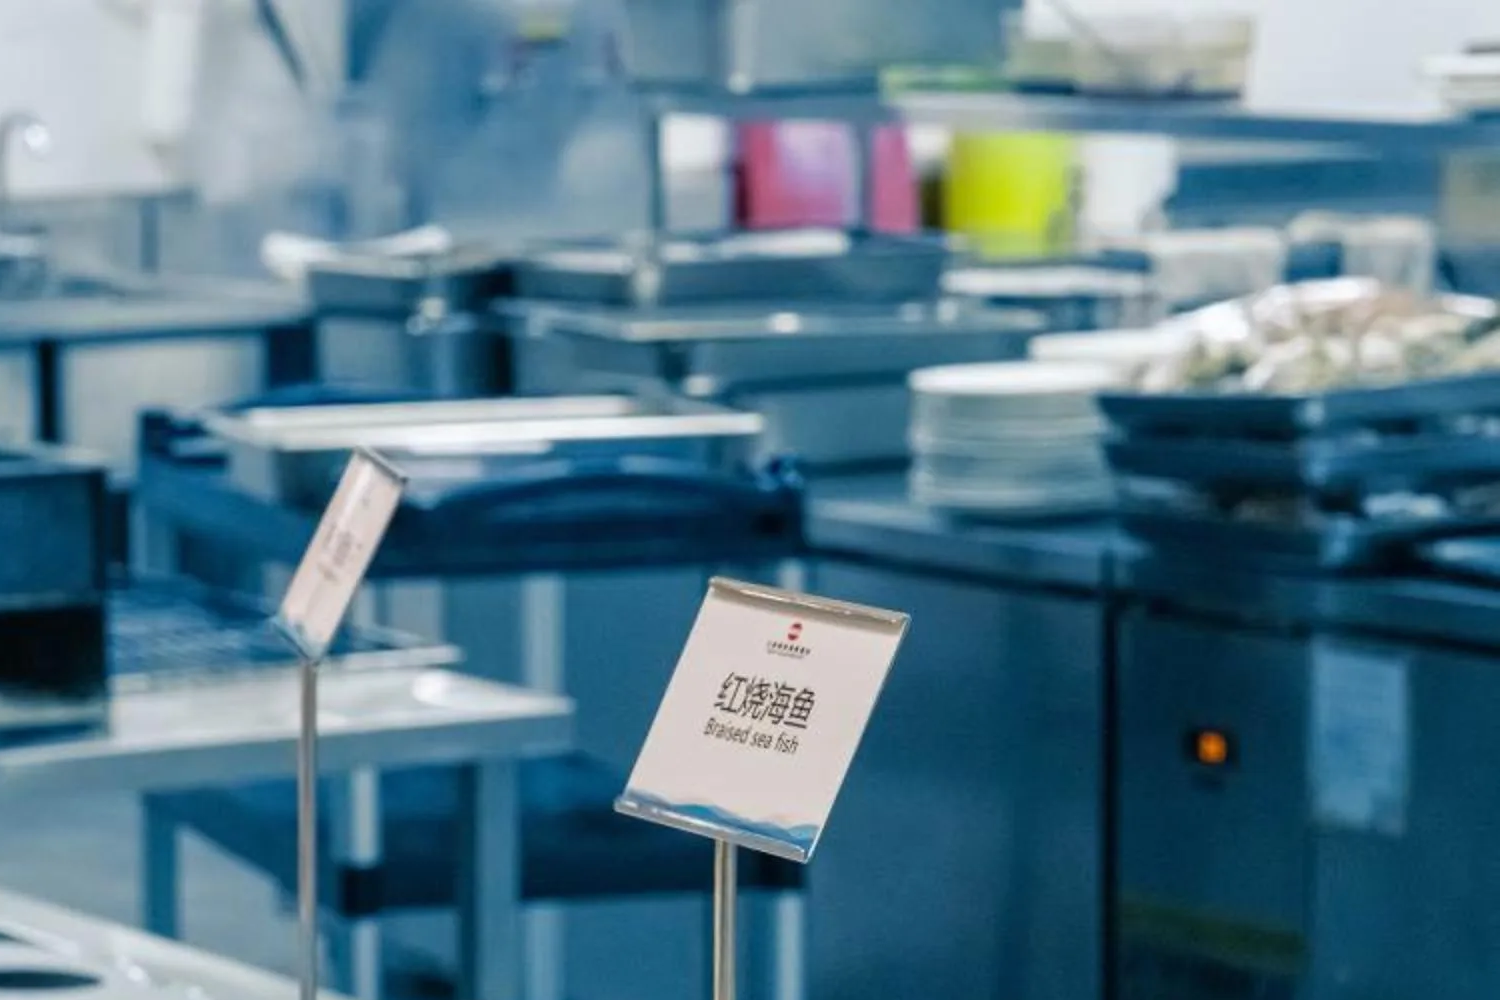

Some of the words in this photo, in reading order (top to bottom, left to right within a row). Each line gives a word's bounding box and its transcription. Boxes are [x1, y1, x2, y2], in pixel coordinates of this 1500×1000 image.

[714, 672, 815, 729] 红烧海鱼
[704, 717, 751, 744] Braised
[749, 731, 773, 750] sea
[775, 731, 799, 754] fish
